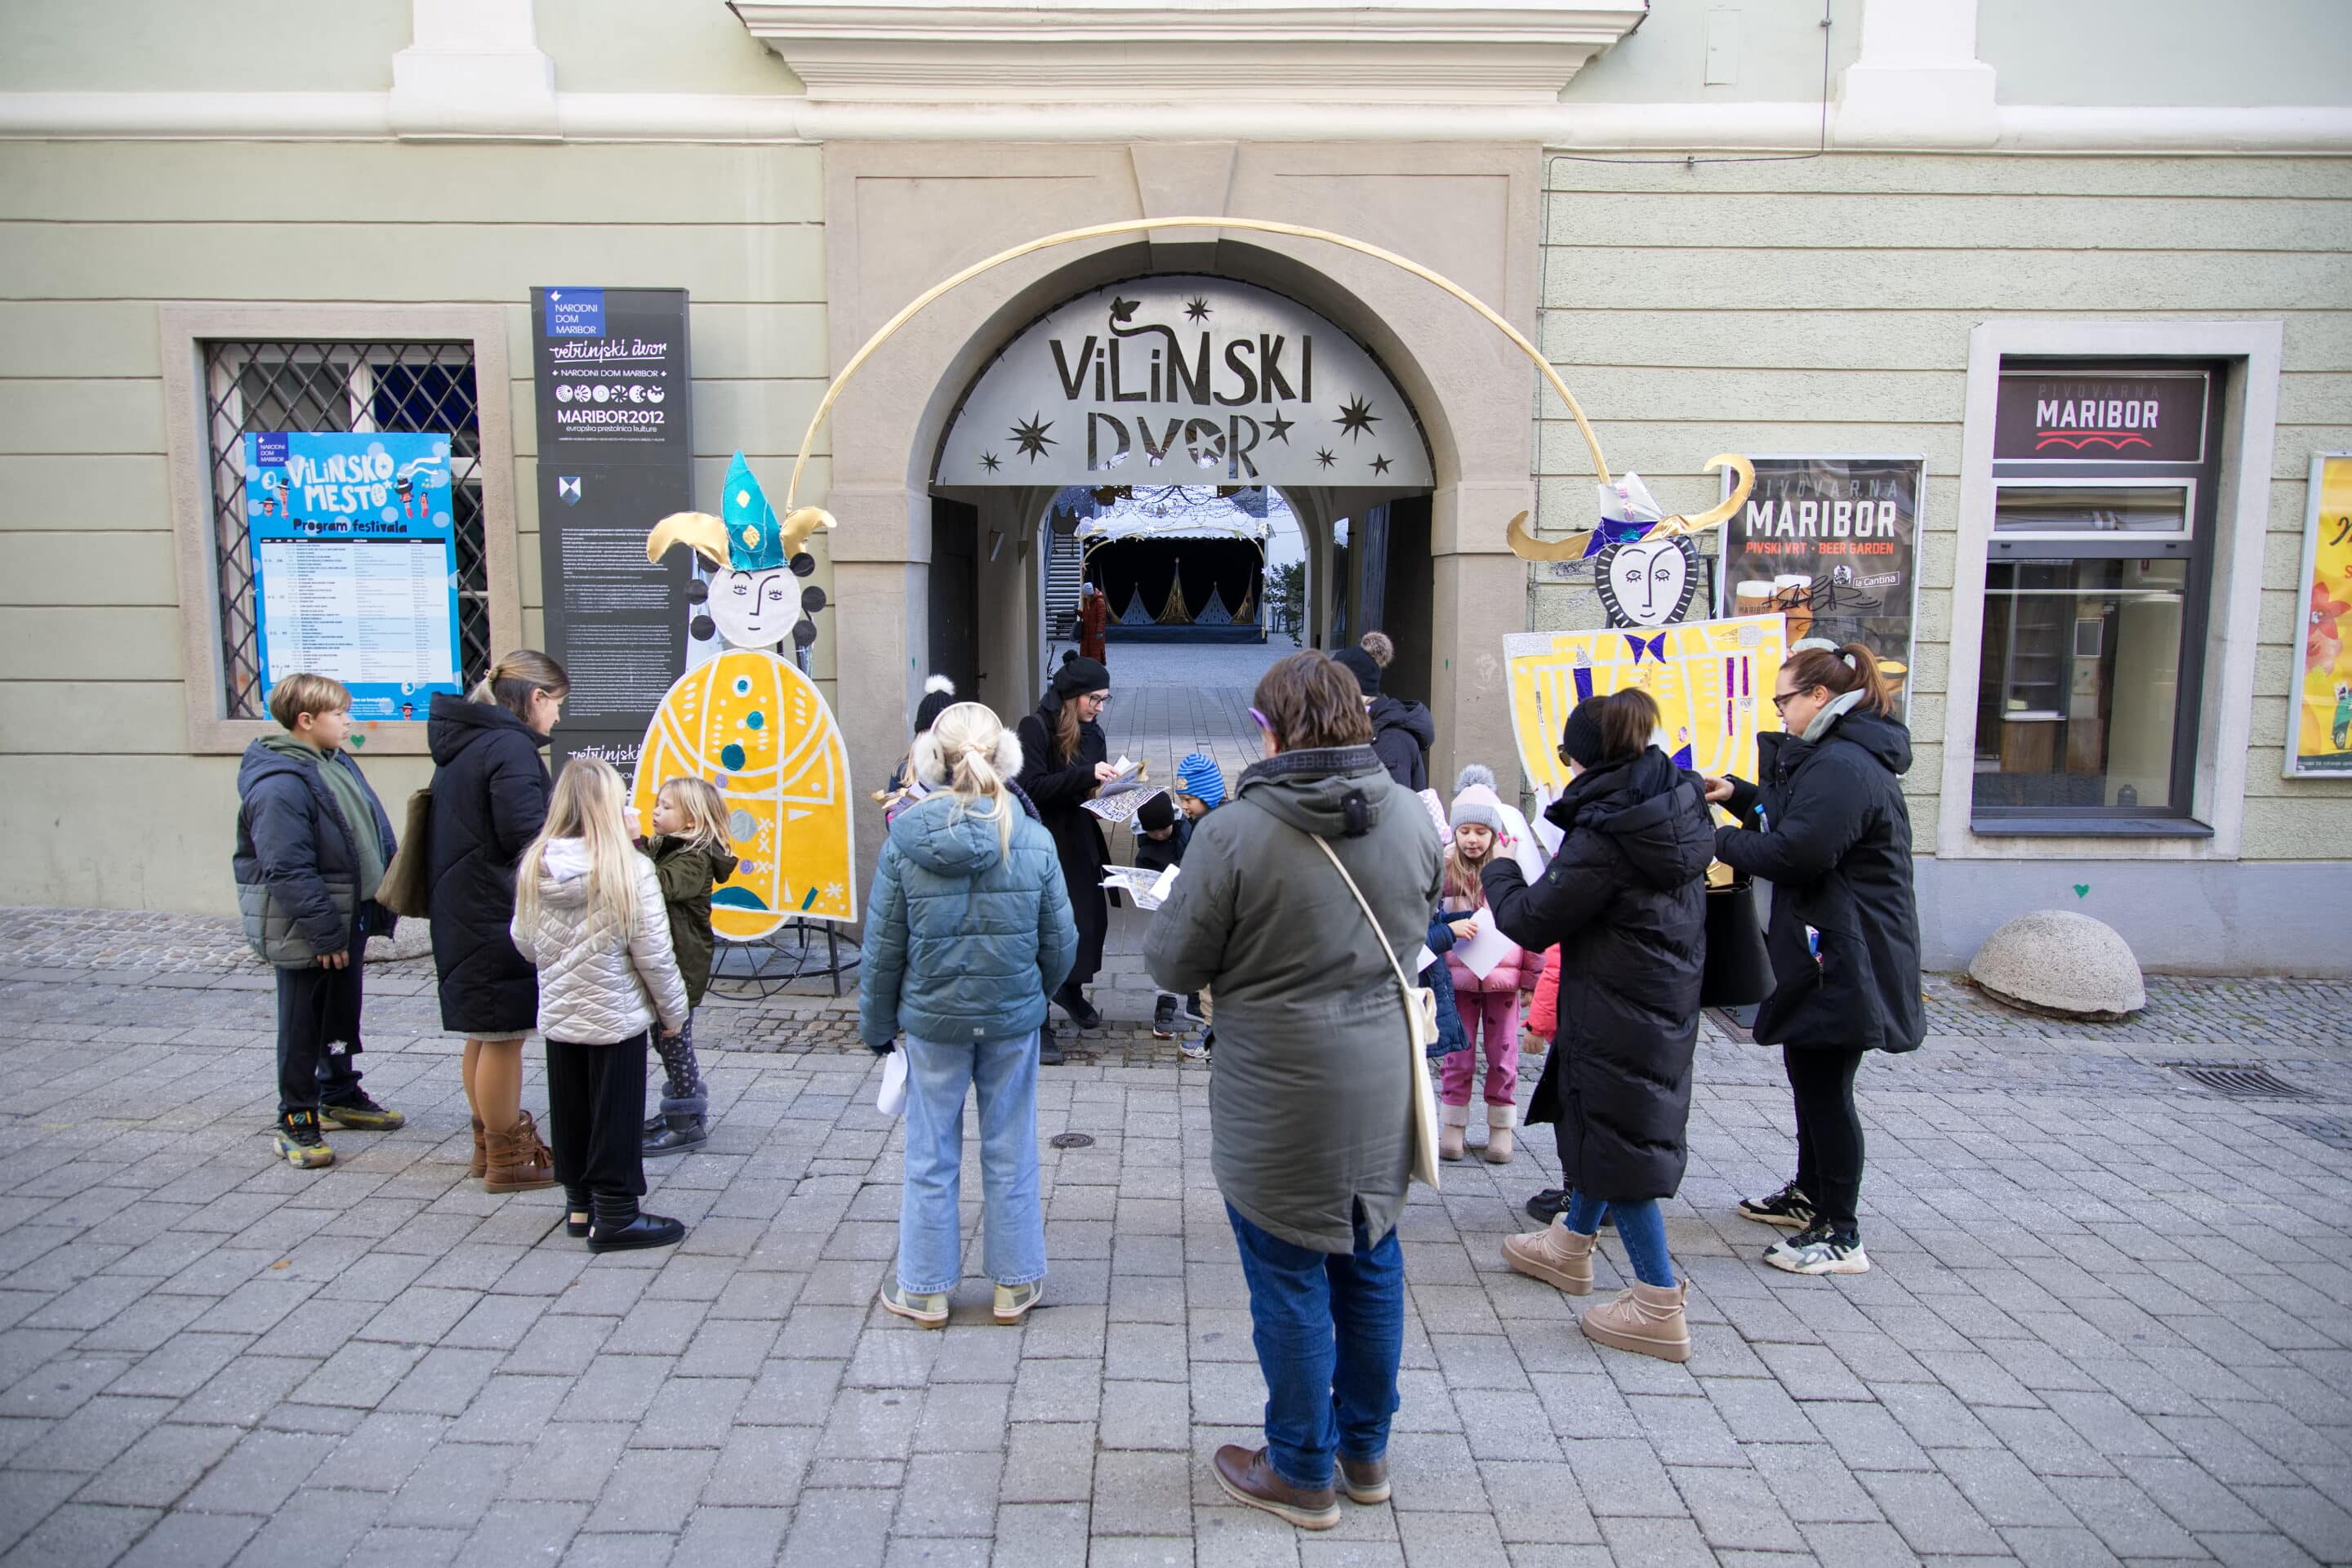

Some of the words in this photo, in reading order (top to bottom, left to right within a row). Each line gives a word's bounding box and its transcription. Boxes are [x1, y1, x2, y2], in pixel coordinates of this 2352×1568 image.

[555, 303, 599, 313] NARODNI
[555, 314, 579, 323] DOM
[555, 325, 597, 334] MARIBOR
[549, 338, 629, 363] vetrinjski
[631, 338, 667, 357] dvor
[2038, 384, 2159, 399] PIVOVARNA
[557, 409, 666, 424] MARIBOR2012
[2036, 399, 2159, 429] MARIBOR
[565, 425, 597, 433] evropska
[1087, 412, 1261, 479] DVOR
[304, 483, 388, 514] MESTO
[292, 518, 348, 534] Program
[353, 519, 408, 534] festivala
[1745, 500, 1897, 537] MARIBOR
[1745, 541, 1781, 555] PIVSKI
[1785, 542, 1807, 555] VRT
[1819, 542, 1846, 555] BEER
[1850, 542, 1894, 555] GARDEN
[1855, 579, 1862, 587] la
[1864, 575, 1896, 586] Cantina
